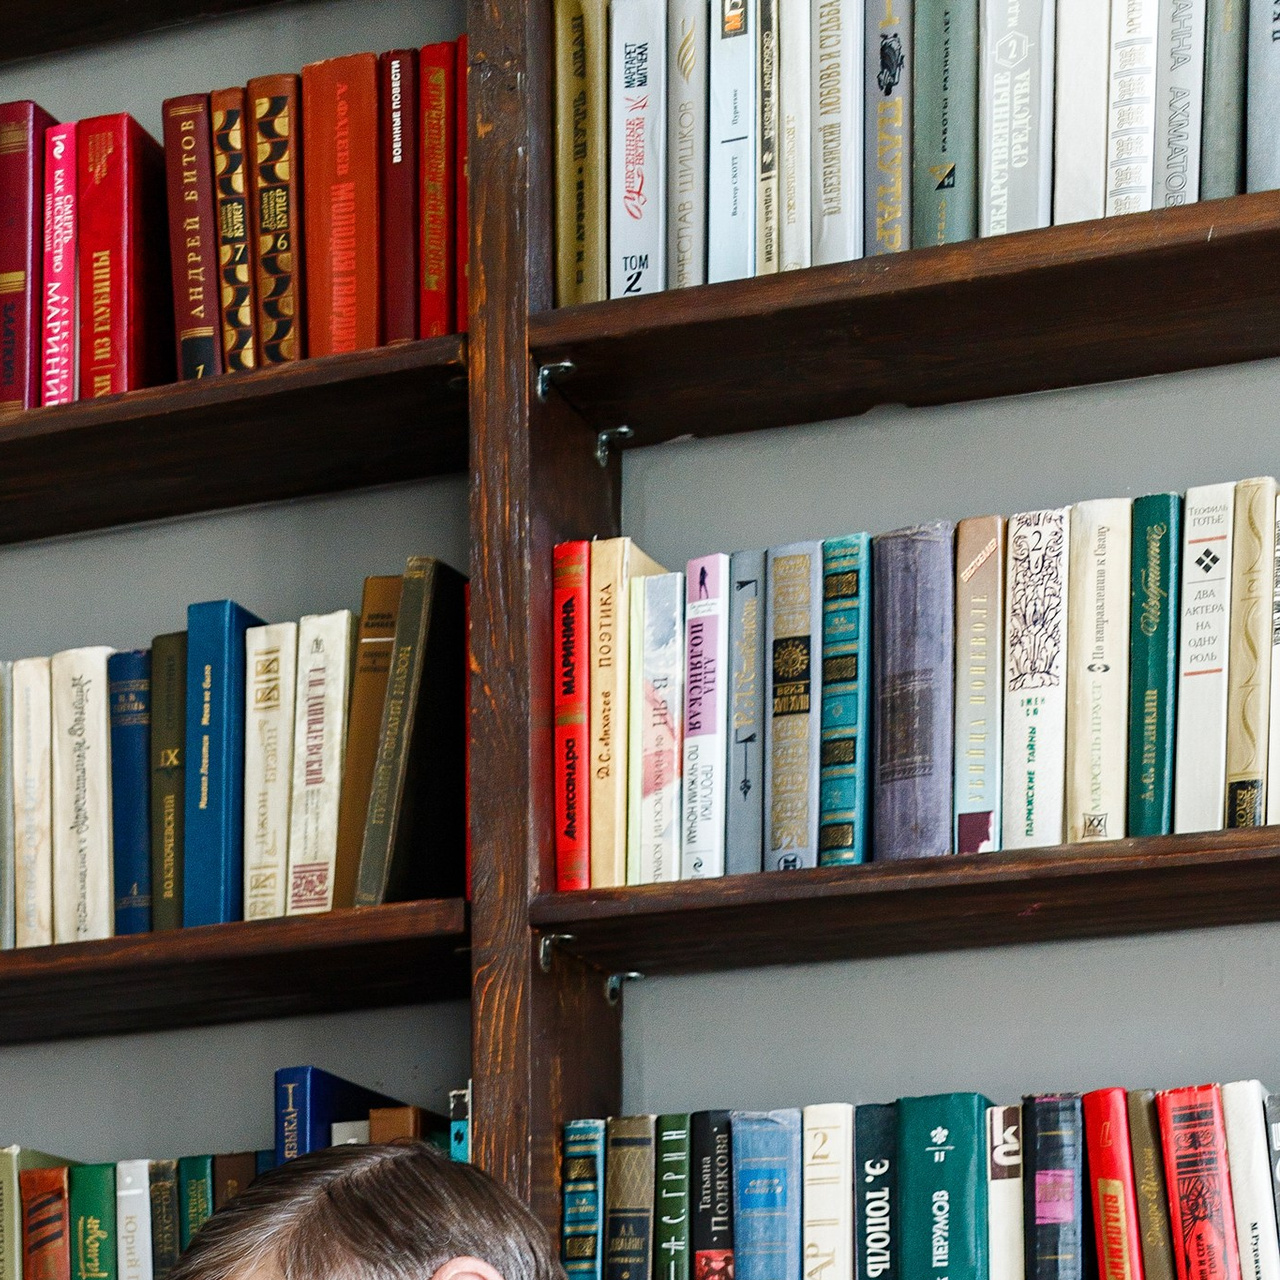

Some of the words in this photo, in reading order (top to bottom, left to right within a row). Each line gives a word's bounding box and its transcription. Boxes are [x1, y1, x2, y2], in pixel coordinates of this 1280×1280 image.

[390, 59, 402, 109] ПОВЕСТИ
[391, 110, 403, 164] ВОЕННЫЕ
[1011, 67, 1032, 168] СРЕДСТВА
[179, 119, 199, 202] БИТОВ
[677, 102, 694, 194] ШИШКОВ
[52, 195, 64, 273] ИСКУССТВО
[63, 194, 74, 246] СМЕРТЬ
[275, 188, 289, 230] КУПЕР
[182, 215, 206, 319] АНДРЕЙ
[233, 245, 246, 262] 7
[622, 255, 649, 272] ТОМ
[93, 249, 111, 334] ГЛУБИНЫ
[622, 271, 643, 295] 2
[93, 337, 111, 360] ИЗ
[1031, 531, 1042, 552] 2
[1184, 604, 1225, 617] АКТЕРА
[1193, 590, 1216, 602] ДВА
[561, 594, 577, 695] МАРИНИНА
[597, 582, 614, 668] ПОЭТИКА
[967, 592, 989, 706] ПОНЕВОЛЕ
[1188, 636, 1218, 650] ОДНУ
[1195, 620, 1212, 631] НА
[689, 622, 705, 733] ПОЛЯНСКАЯ
[703, 656, 716, 695] АЛЛА
[1189, 653, 1217, 665] РОЛЬ
[965, 717, 988, 803] УБИЙЦА
[1025, 725, 1037, 763] ТАЙНЫ
[562, 737, 577, 841] Александра
[699, 763, 713, 821] ПРОГУЛКИ
[1024, 769, 1036, 837] ПАРИЖСКИЕ
[686, 803, 699, 845] НОЧАМ
[813, 1131, 830, 1160] 2
[698, 1155, 713, 1212] Татьяна
[711, 1132, 730, 1232] Полякова
[77, 1215, 109, 1280] Гамсун
[124, 1215, 139, 1268] Юрий
[864, 1187, 890, 1277] ТОПОЛЬ
[931, 1189, 950, 1268] ПЕРУМОВ
[1100, 1194, 1123, 1280] ВЛАДИМИР
